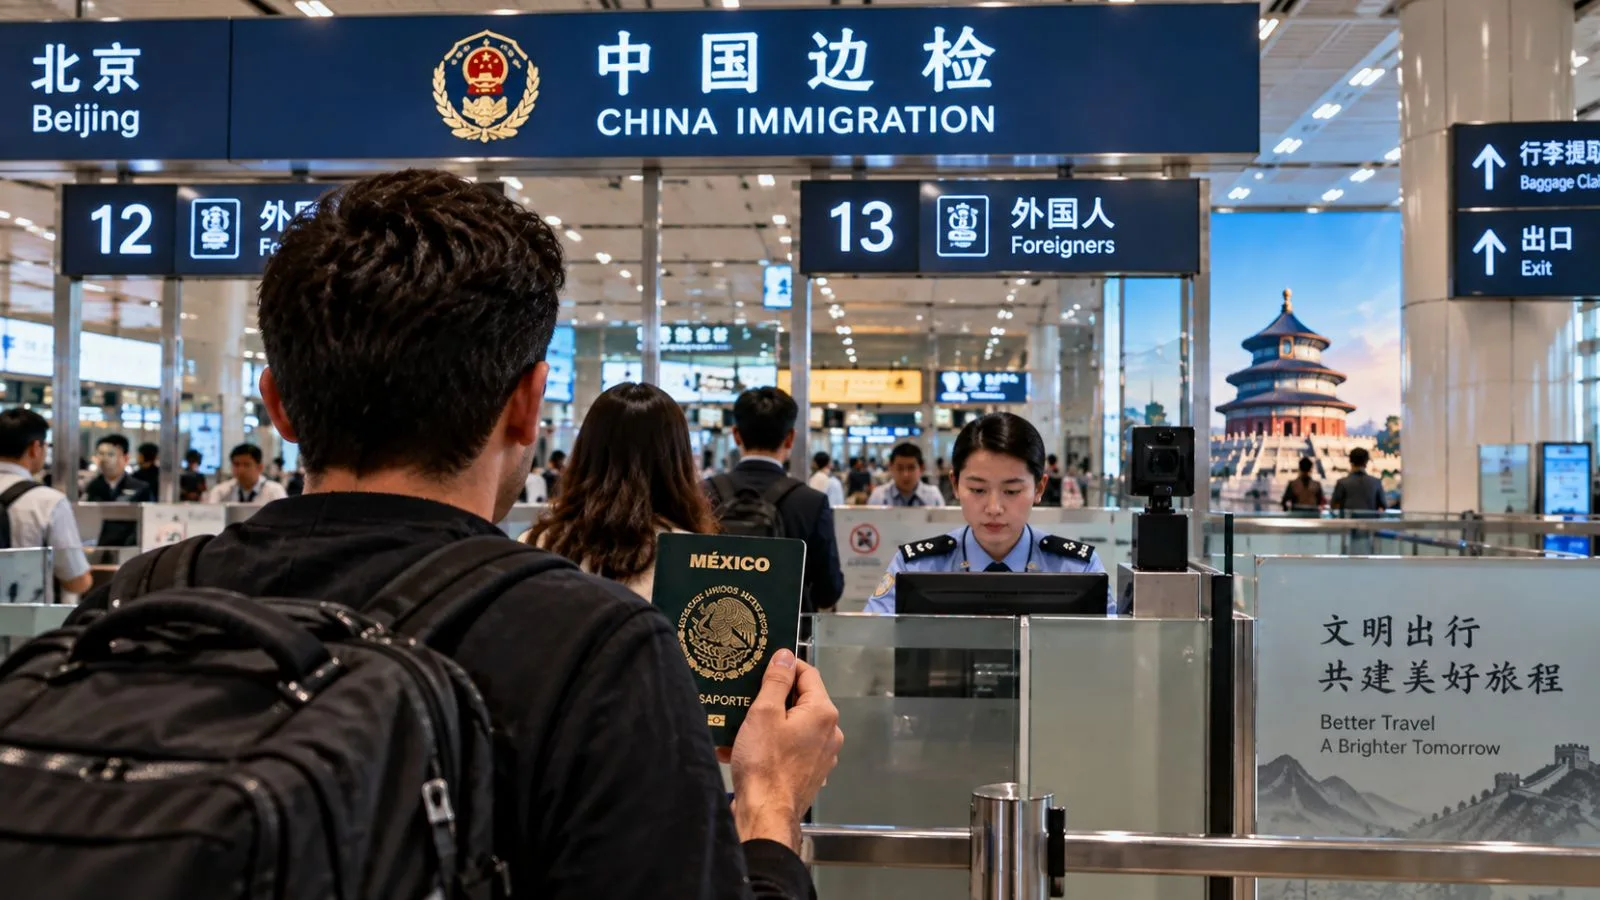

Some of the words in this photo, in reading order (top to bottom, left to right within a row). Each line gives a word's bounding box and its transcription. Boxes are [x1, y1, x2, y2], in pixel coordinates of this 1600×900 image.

[31, 42, 141, 94] 北京
[597, 26, 996, 96] 中国边检
[32, 104, 140, 138] Beijing
[596, 107, 718, 136] CHINA
[737, 105, 995, 135] IMMIGRATION
[1520, 174, 1575, 193] Baggage
[90, 203, 153, 255] 12
[830, 200, 894, 252] 13
[1010, 196, 1115, 230] 外国人
[1011, 235, 1115, 258] Foreigners
[1522, 226, 1572, 252] 出口
[1521, 259, 1553, 276] Exit
[689, 551, 771, 572] MÉXICO
[1320, 614, 1481, 649] 文明出行
[1318, 659, 1564, 695] 共建美好旅程
[1320, 714, 1376, 731] Better
[1381, 714, 1435, 732] Travel
[1320, 737, 1333, 753] A
[1338, 738, 1407, 758] Brighter
[1412, 738, 1501, 756] Tomorrow
